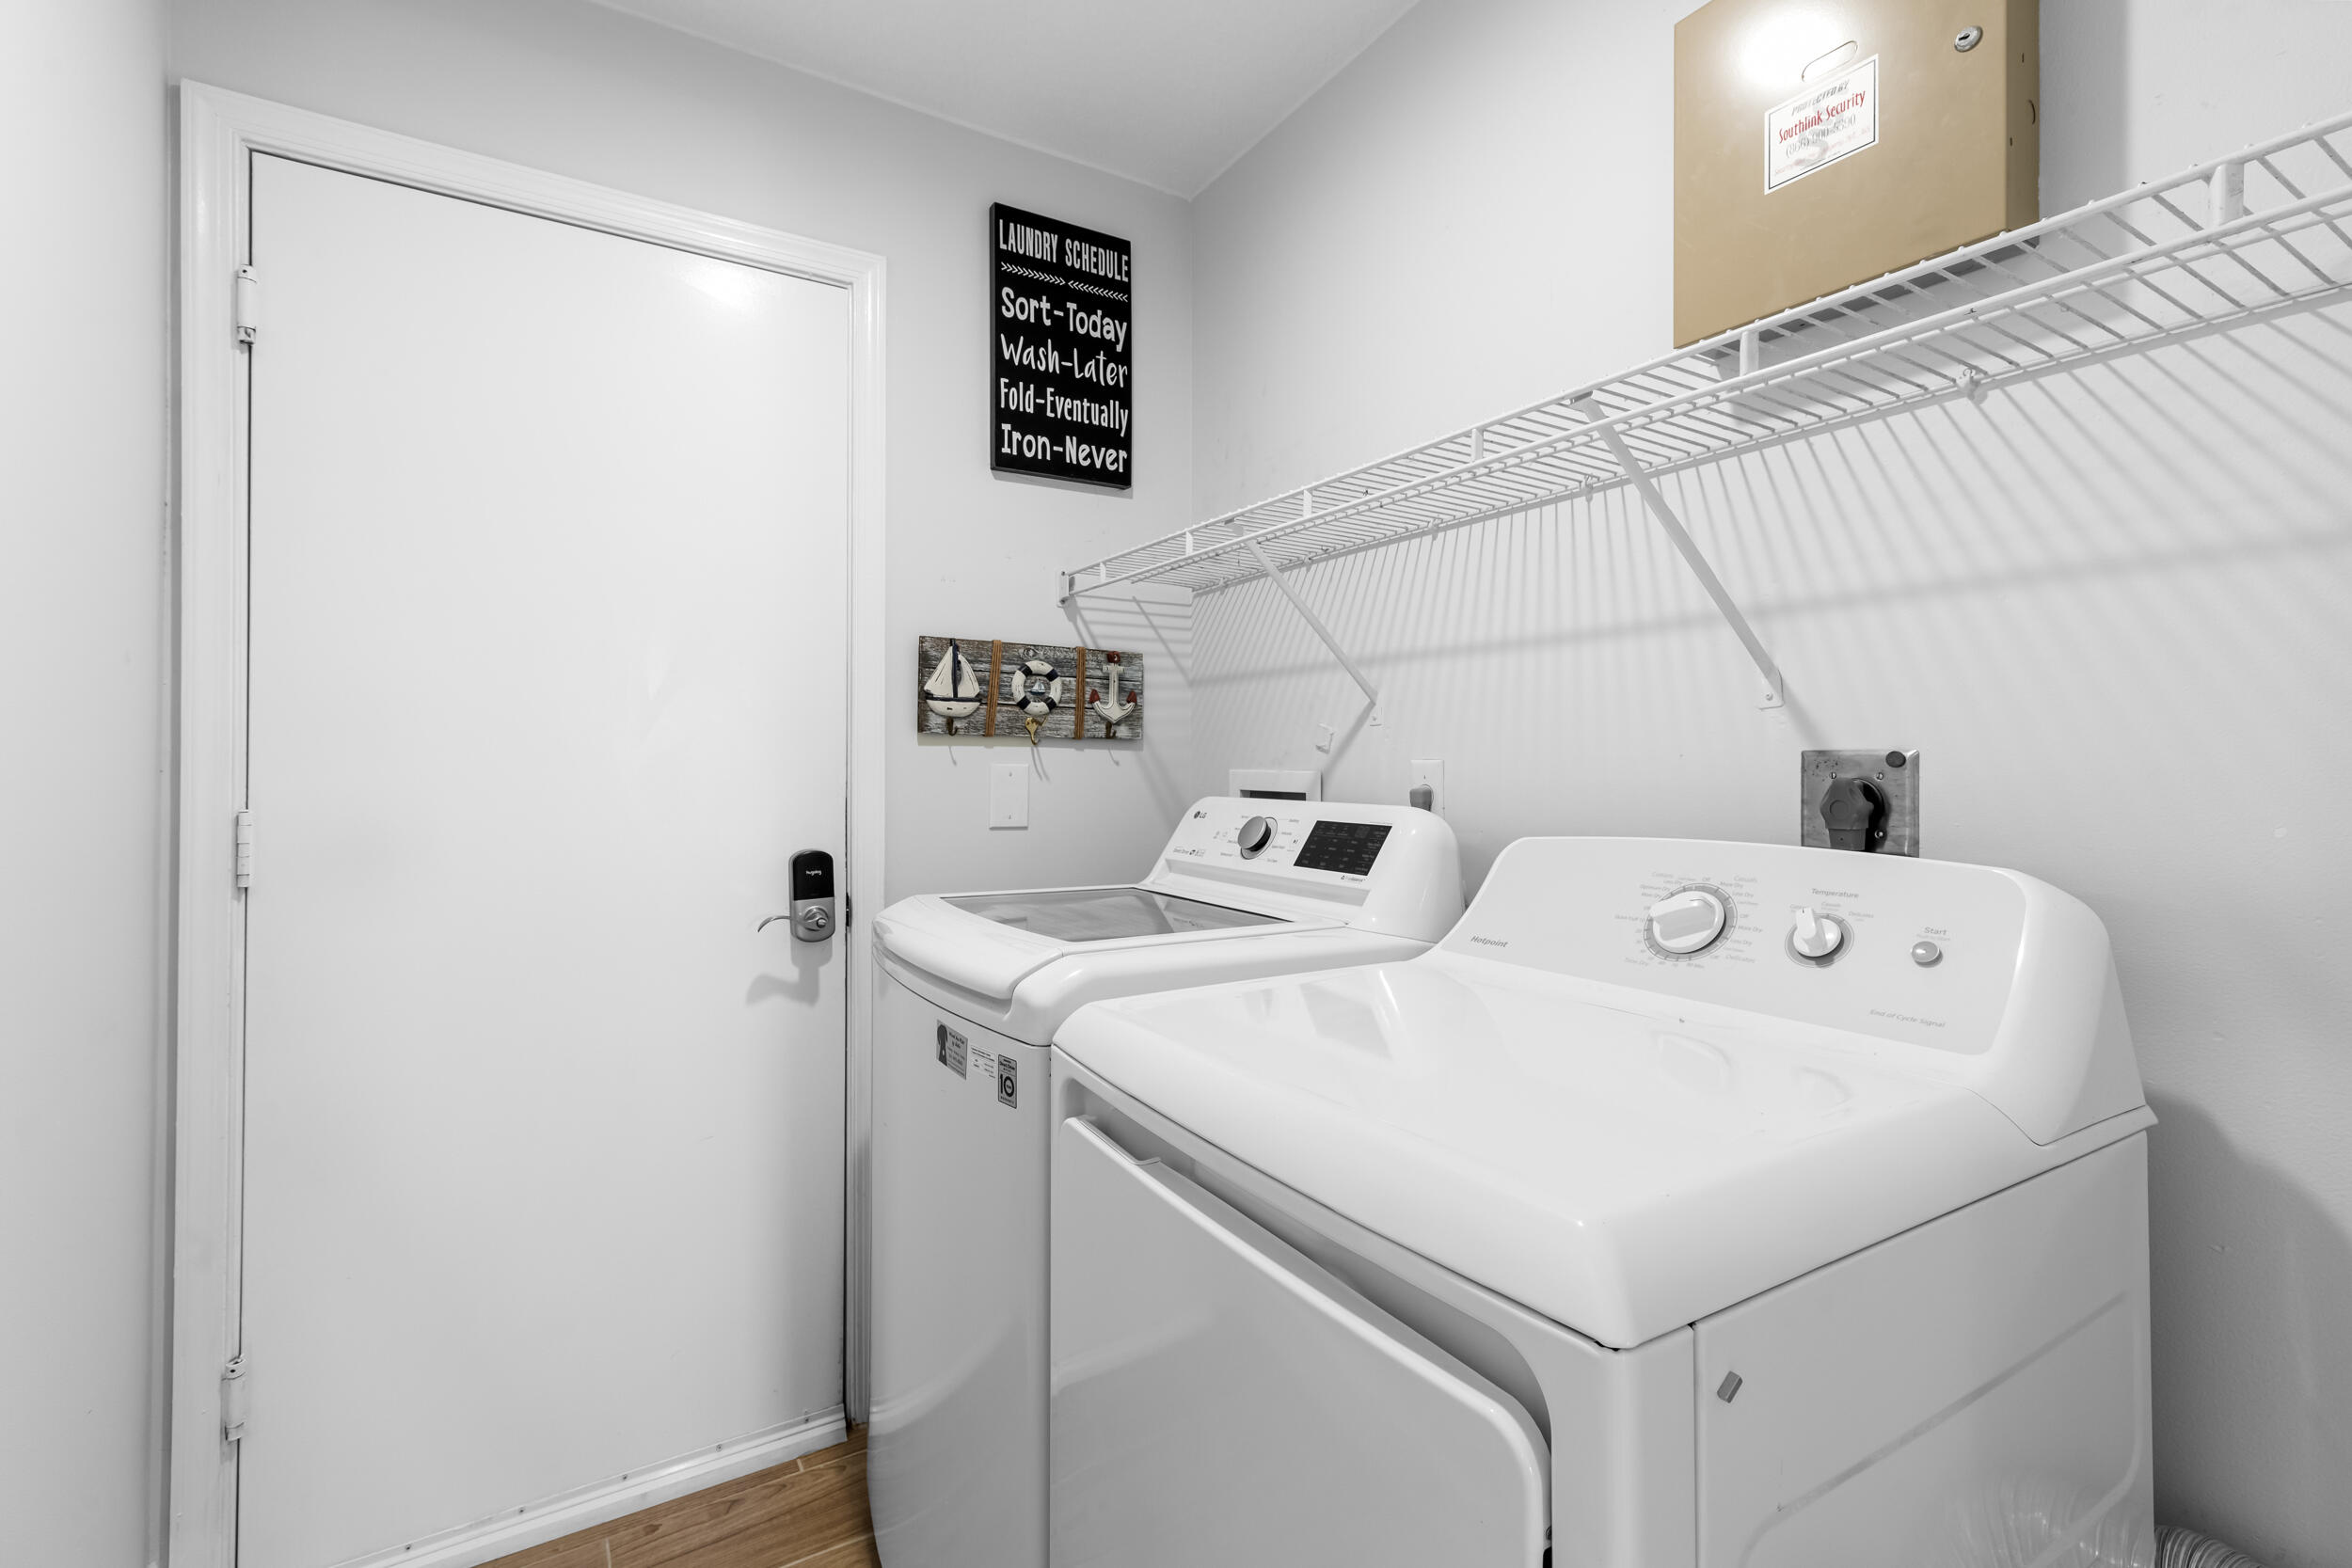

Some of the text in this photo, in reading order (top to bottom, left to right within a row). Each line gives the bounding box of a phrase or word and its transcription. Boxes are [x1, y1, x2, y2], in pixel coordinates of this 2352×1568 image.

[1778, 90, 1867, 144] Southlink Security
[999, 218, 1129, 283] LAUNDRY SCHEDULE
[1001, 286, 1128, 353] Sort-Today
[1000, 333, 1128, 388] Wash-Later
[1000, 377, 1129, 437] Fold-Eventually
[1001, 423, 1128, 472] Iron-Never
[1811, 888, 1860, 898] Temperature
[1470, 935, 1509, 948] Hotpoint
[1924, 927, 1947, 936] Start
[1896, 1014, 1918, 1023] Cycle
[1918, 1018, 1947, 1028] Signal
